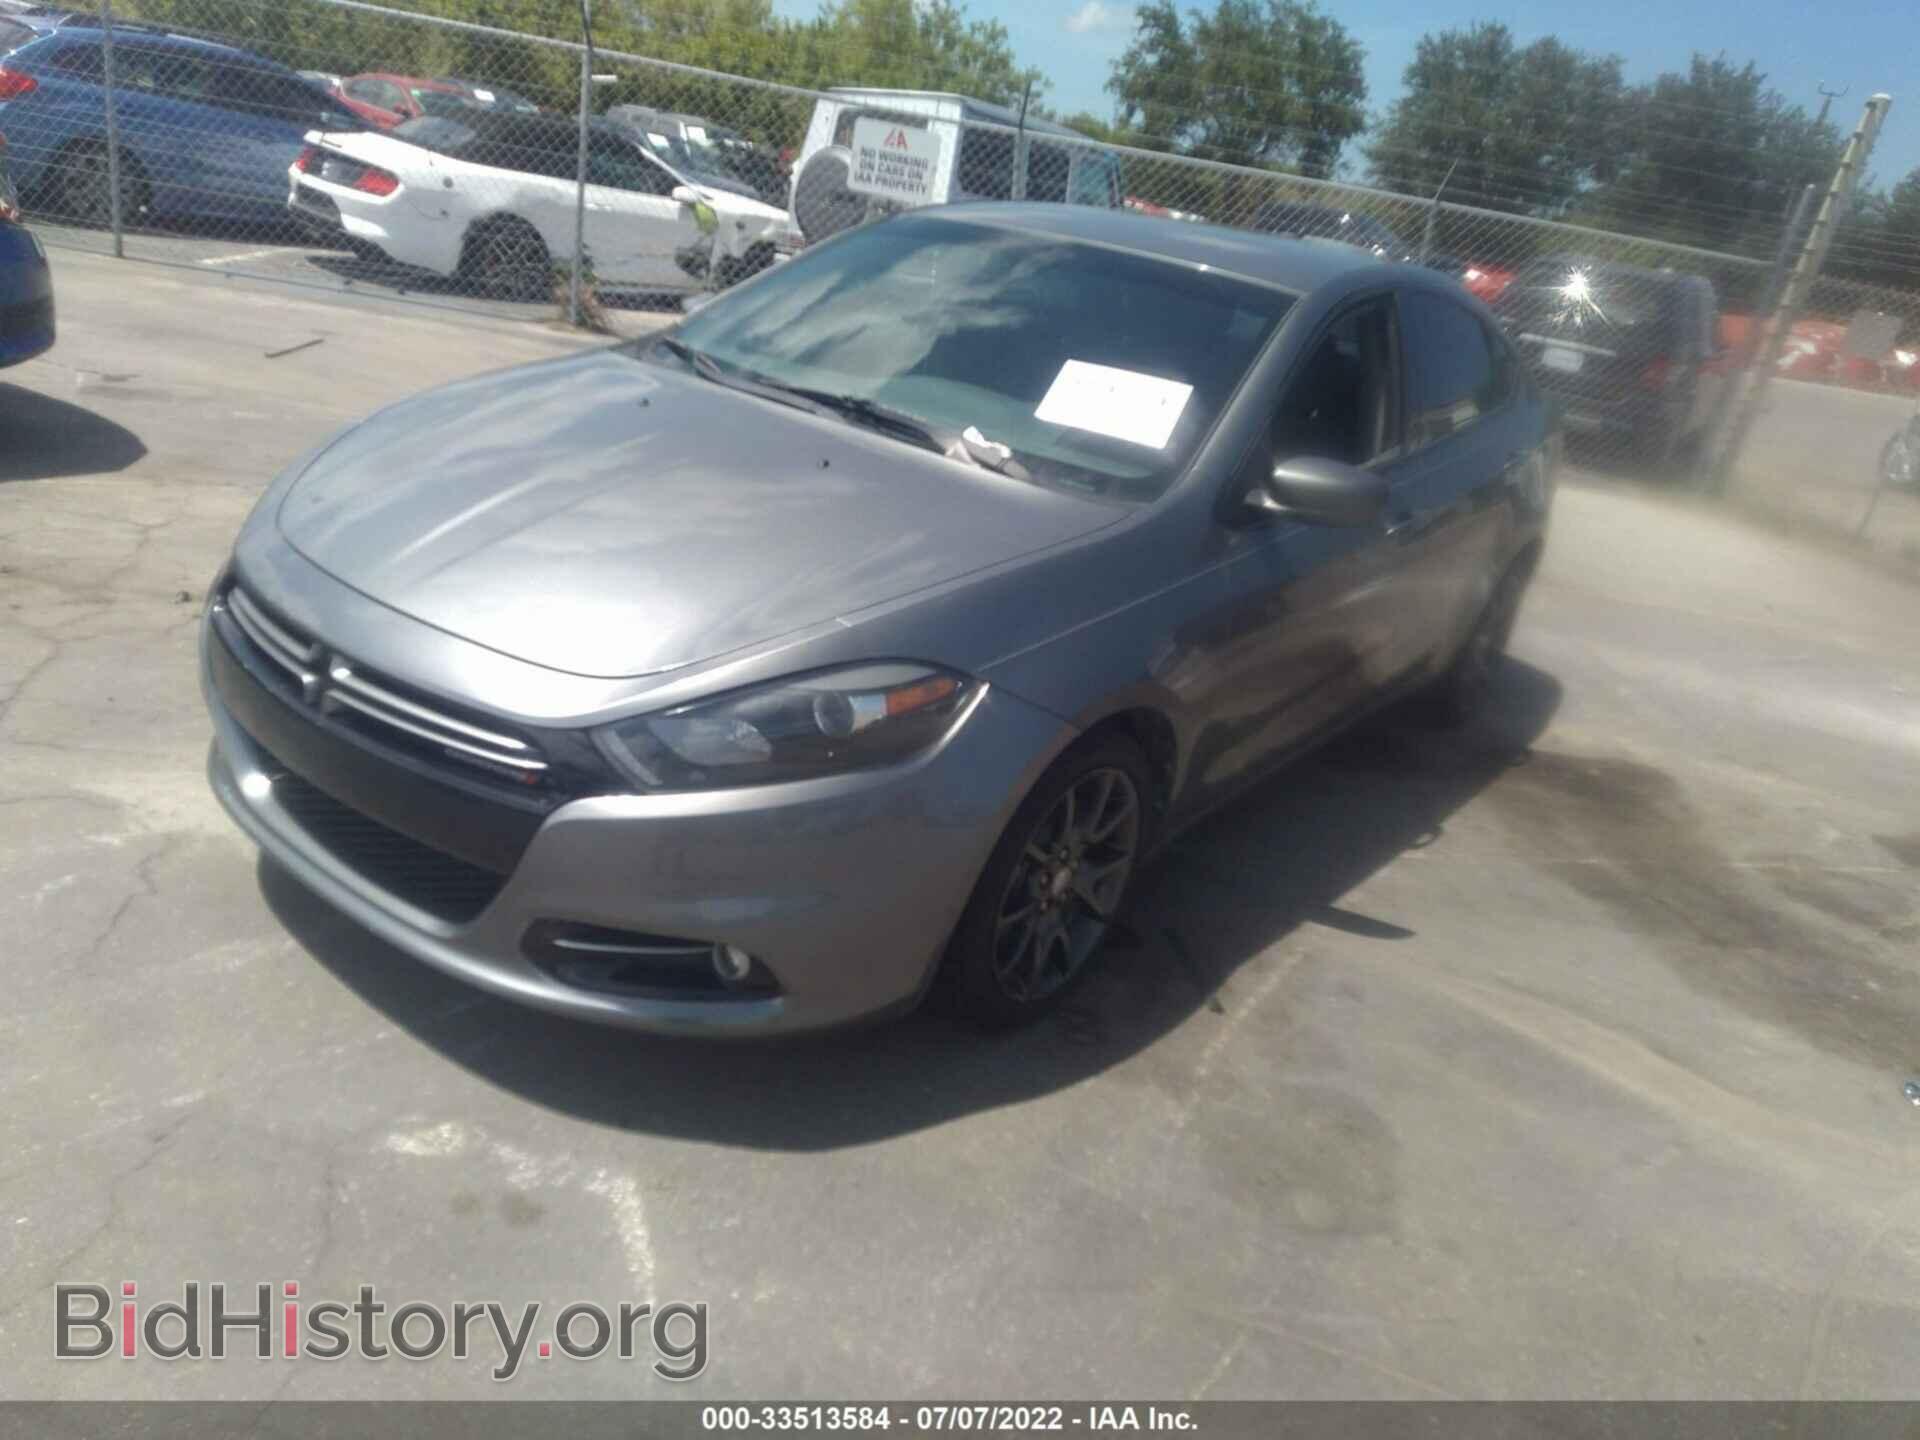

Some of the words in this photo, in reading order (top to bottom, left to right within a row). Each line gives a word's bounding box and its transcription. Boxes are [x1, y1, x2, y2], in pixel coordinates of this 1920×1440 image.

[860, 147, 876, 159] NO
[859, 158, 875, 172] ON
[877, 161, 905, 177] CARS
[907, 167, 923, 181] ON
[854, 170, 873, 184] IAA
[874, 173, 927, 195] PROPERTY
